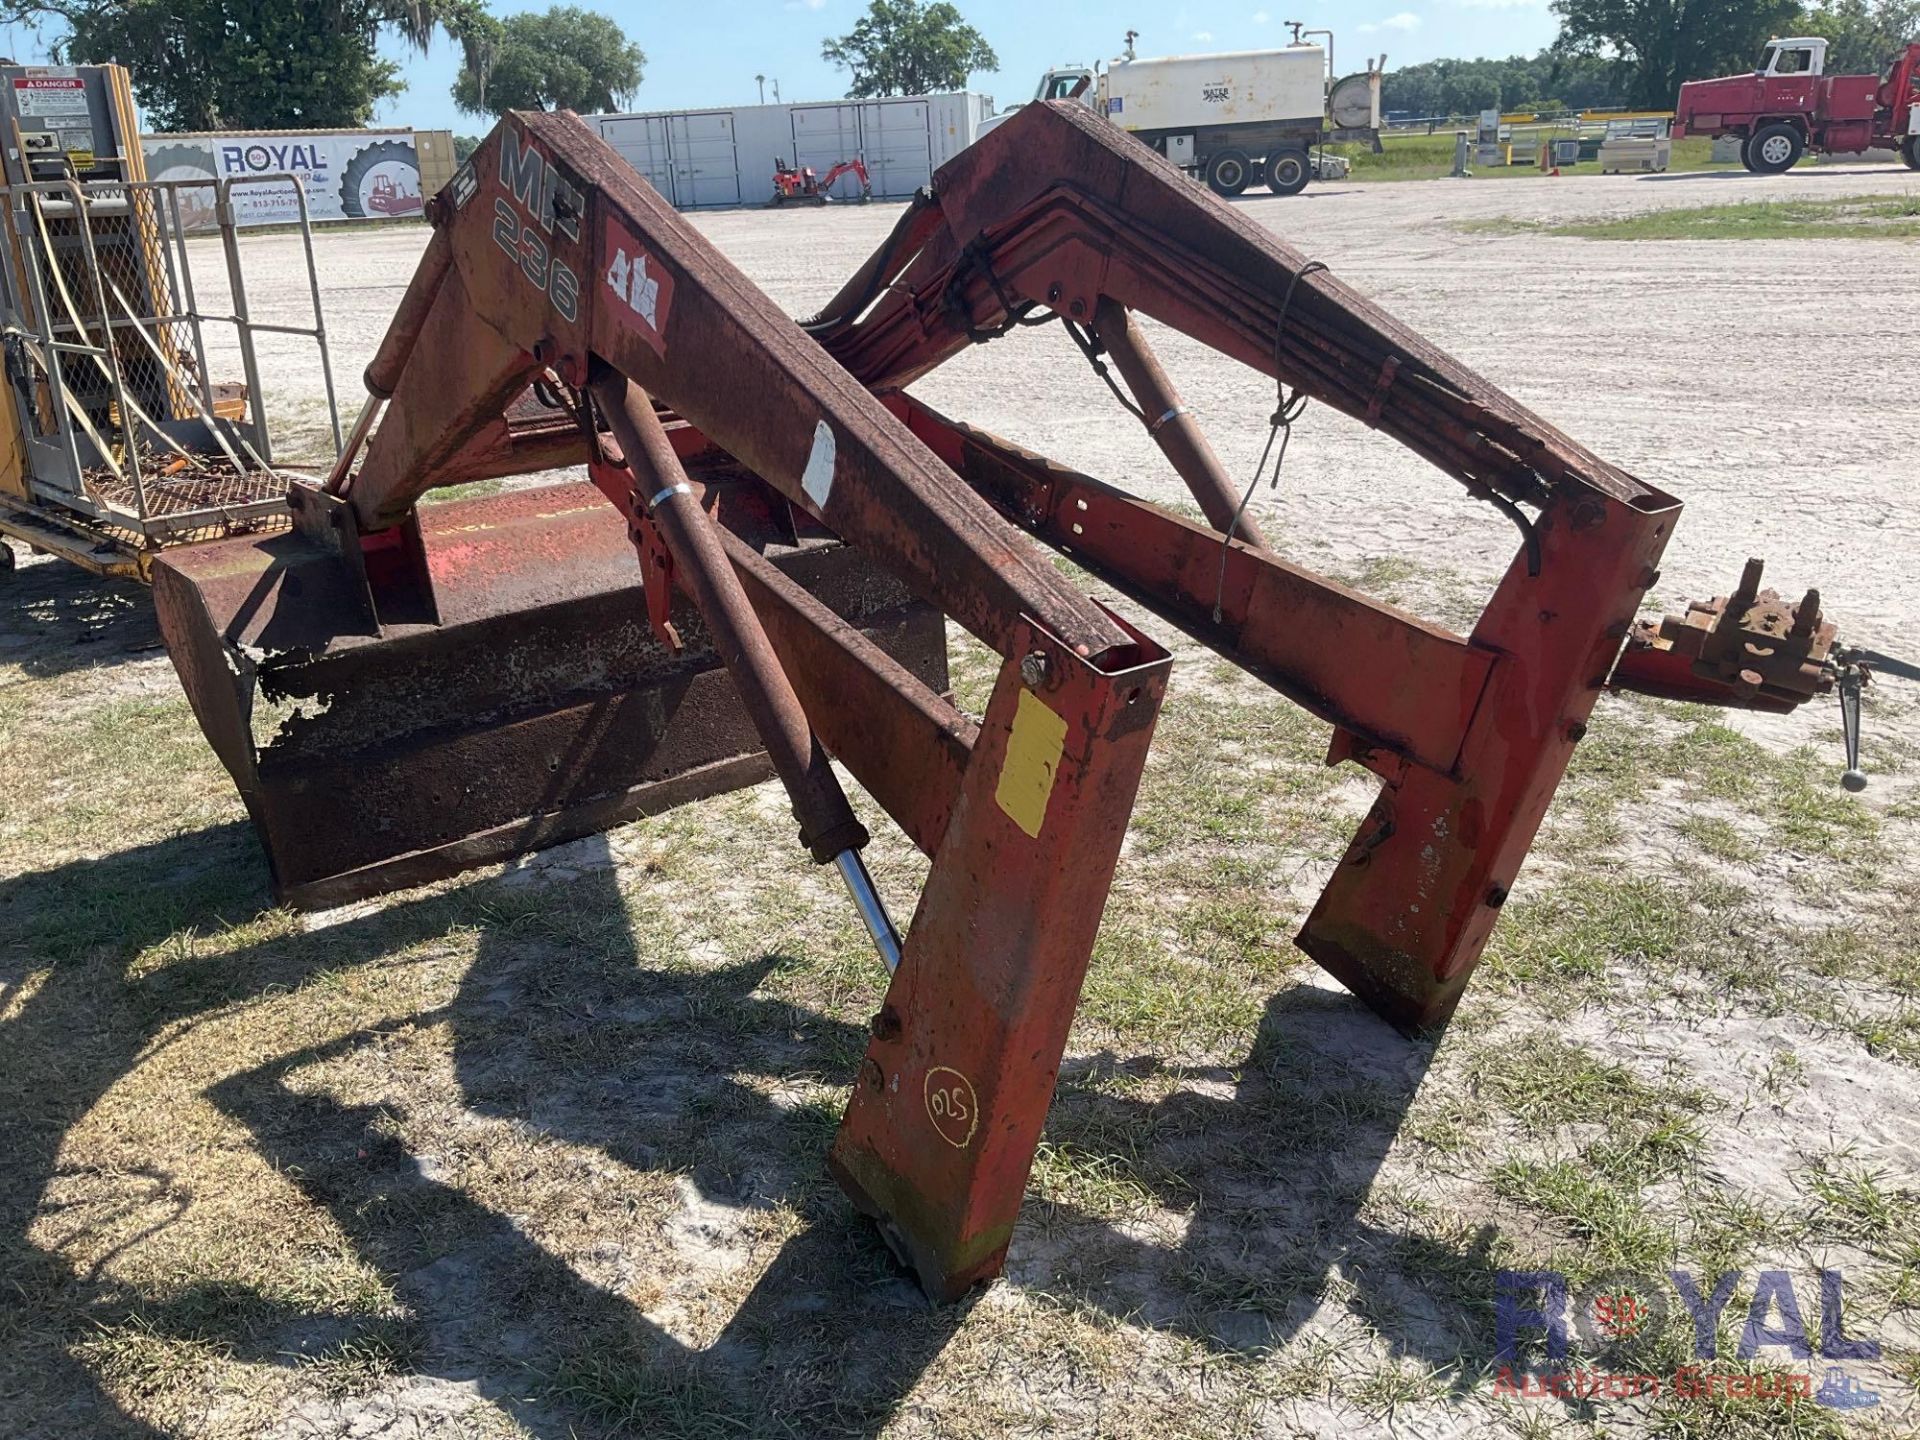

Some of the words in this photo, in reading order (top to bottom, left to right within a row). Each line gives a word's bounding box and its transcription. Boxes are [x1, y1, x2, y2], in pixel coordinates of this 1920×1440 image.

[35, 80, 76, 88] DANGER
[1203, 87, 1229, 97] WATER
[222, 144, 328, 172] ROYAL
[231, 187, 326, 196] www.RoyalAuctionGup.com
[493, 197, 579, 323] 236
